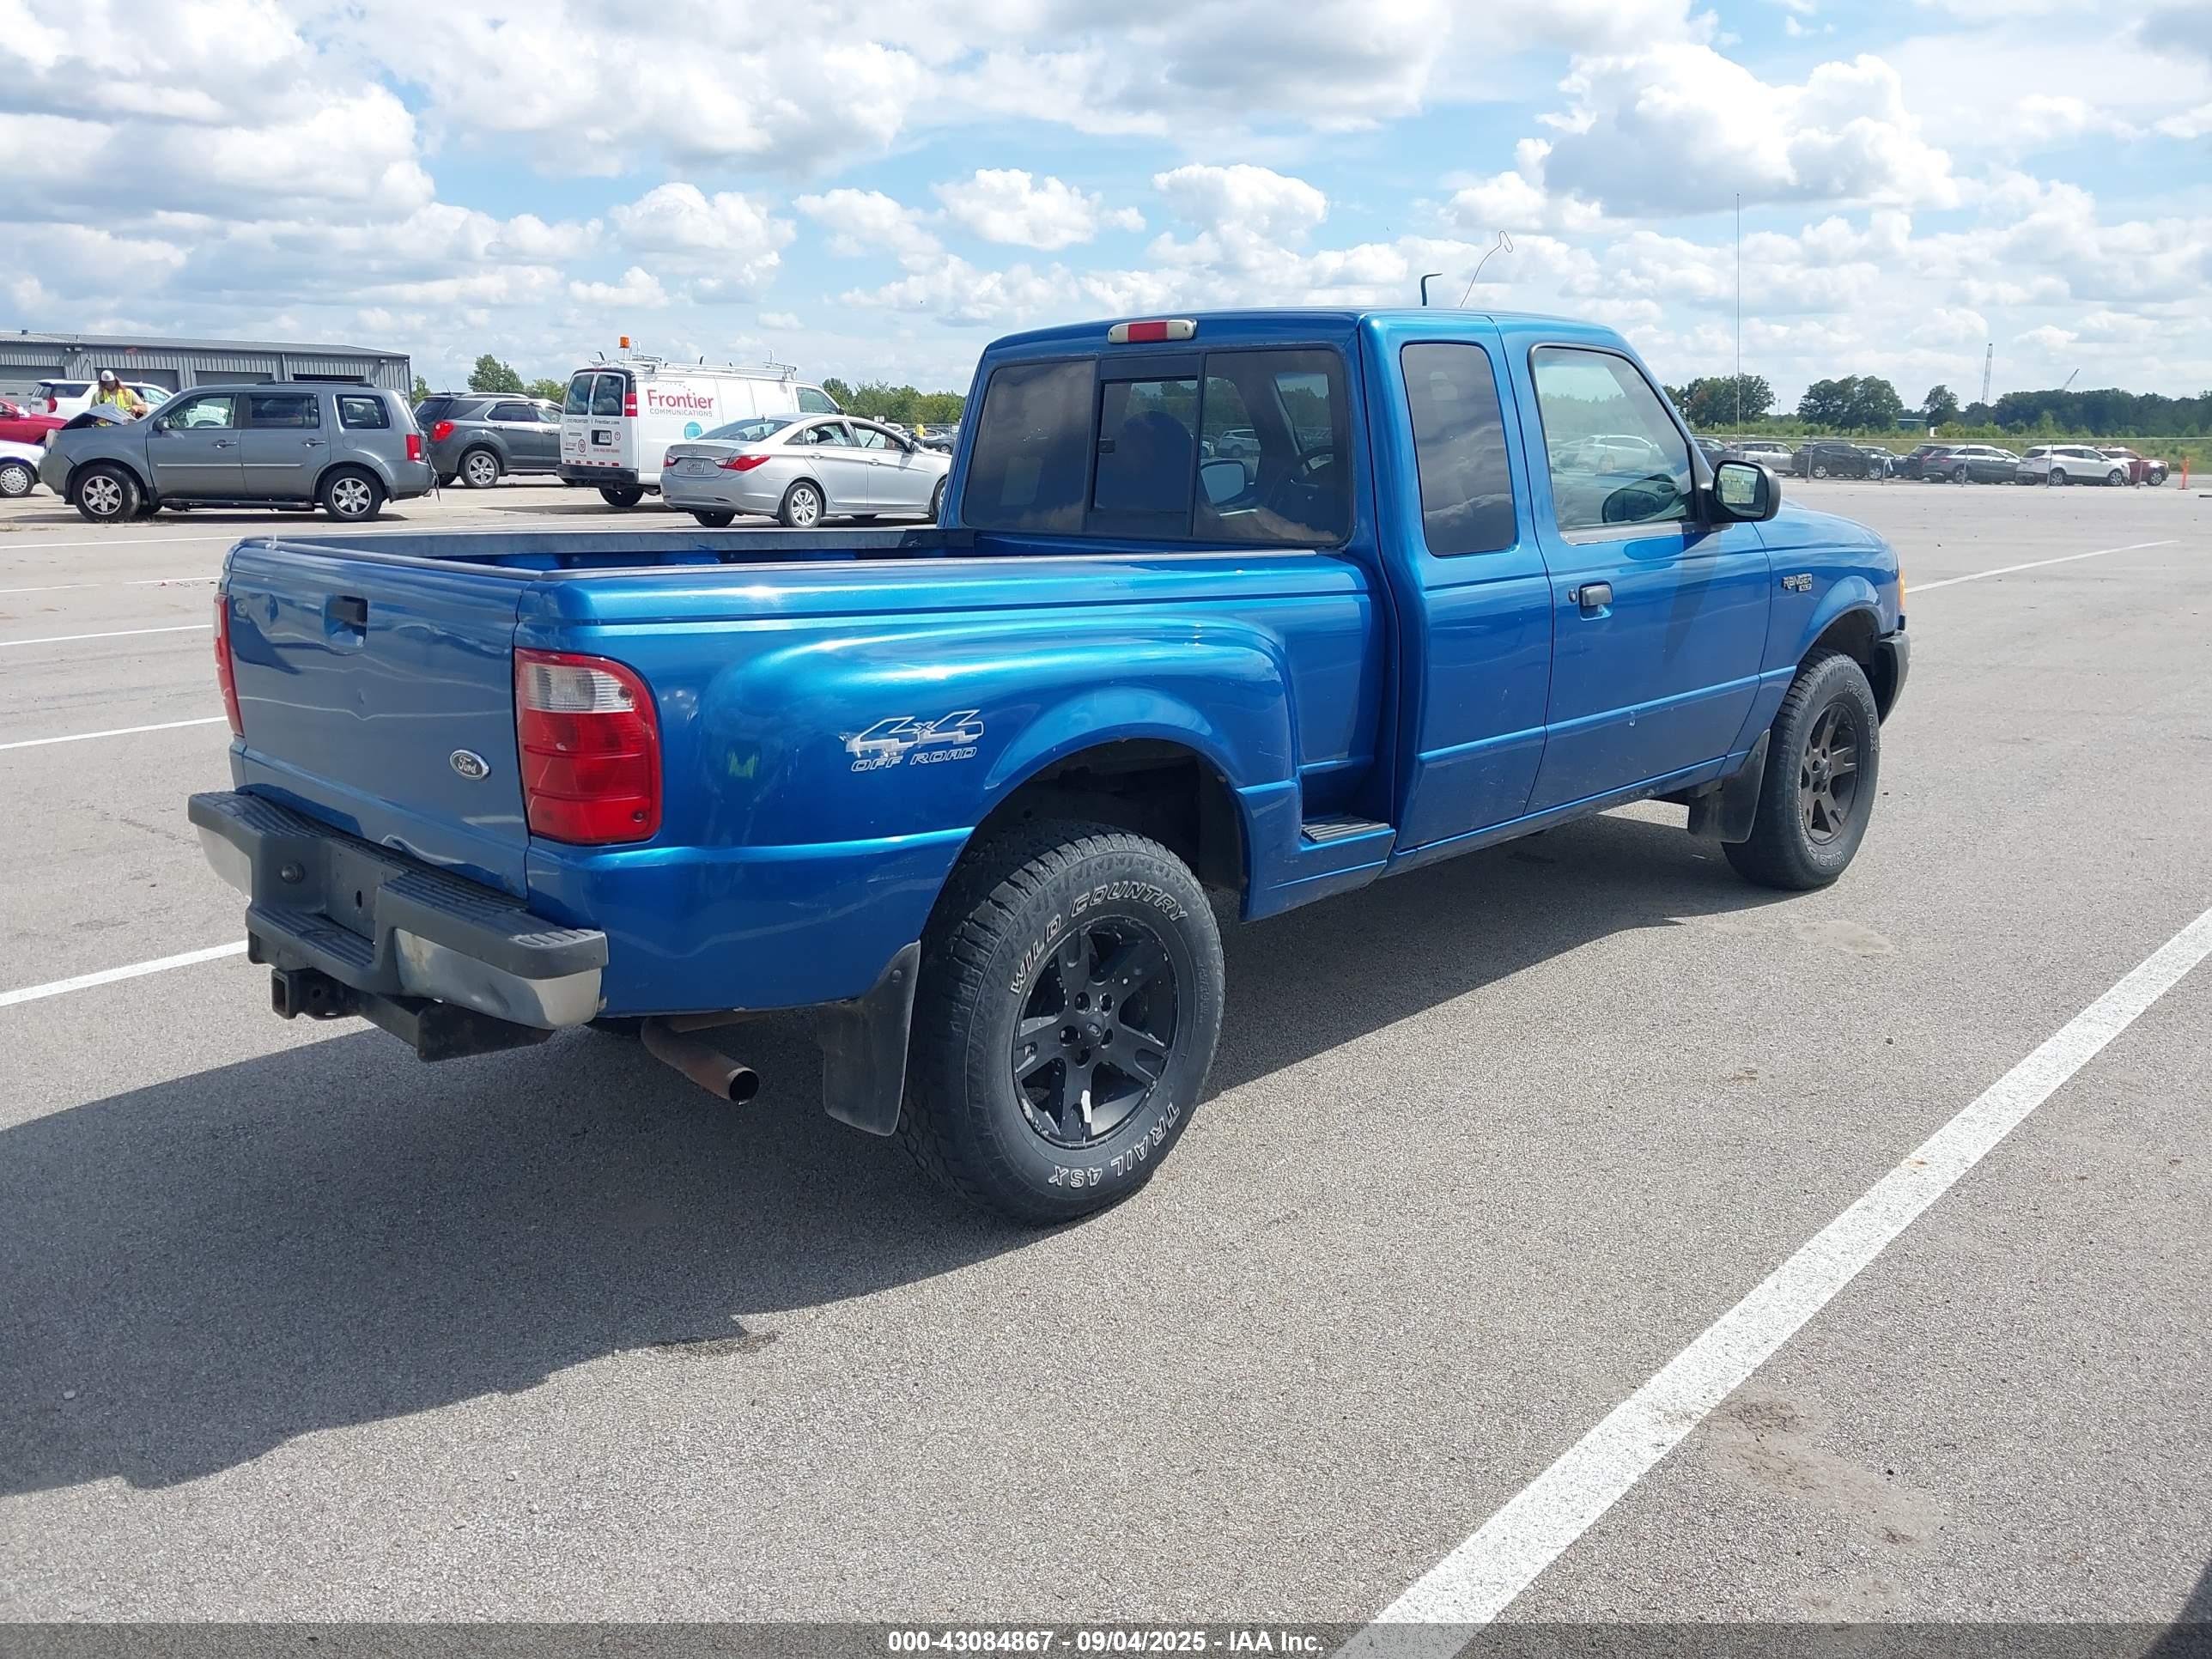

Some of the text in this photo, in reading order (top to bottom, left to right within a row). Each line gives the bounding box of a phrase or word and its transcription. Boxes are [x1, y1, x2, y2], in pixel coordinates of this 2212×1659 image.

[647, 389, 714, 409] Frontier
[649, 408, 713, 417] COMMUNICATIONS
[1783, 573, 1813, 589] RANGER
[851, 746, 977, 772] OFF ROAD
[1011, 880, 1188, 994] WILD COUNTRY
[1048, 1102, 1181, 1189] TRAIL 4SX
